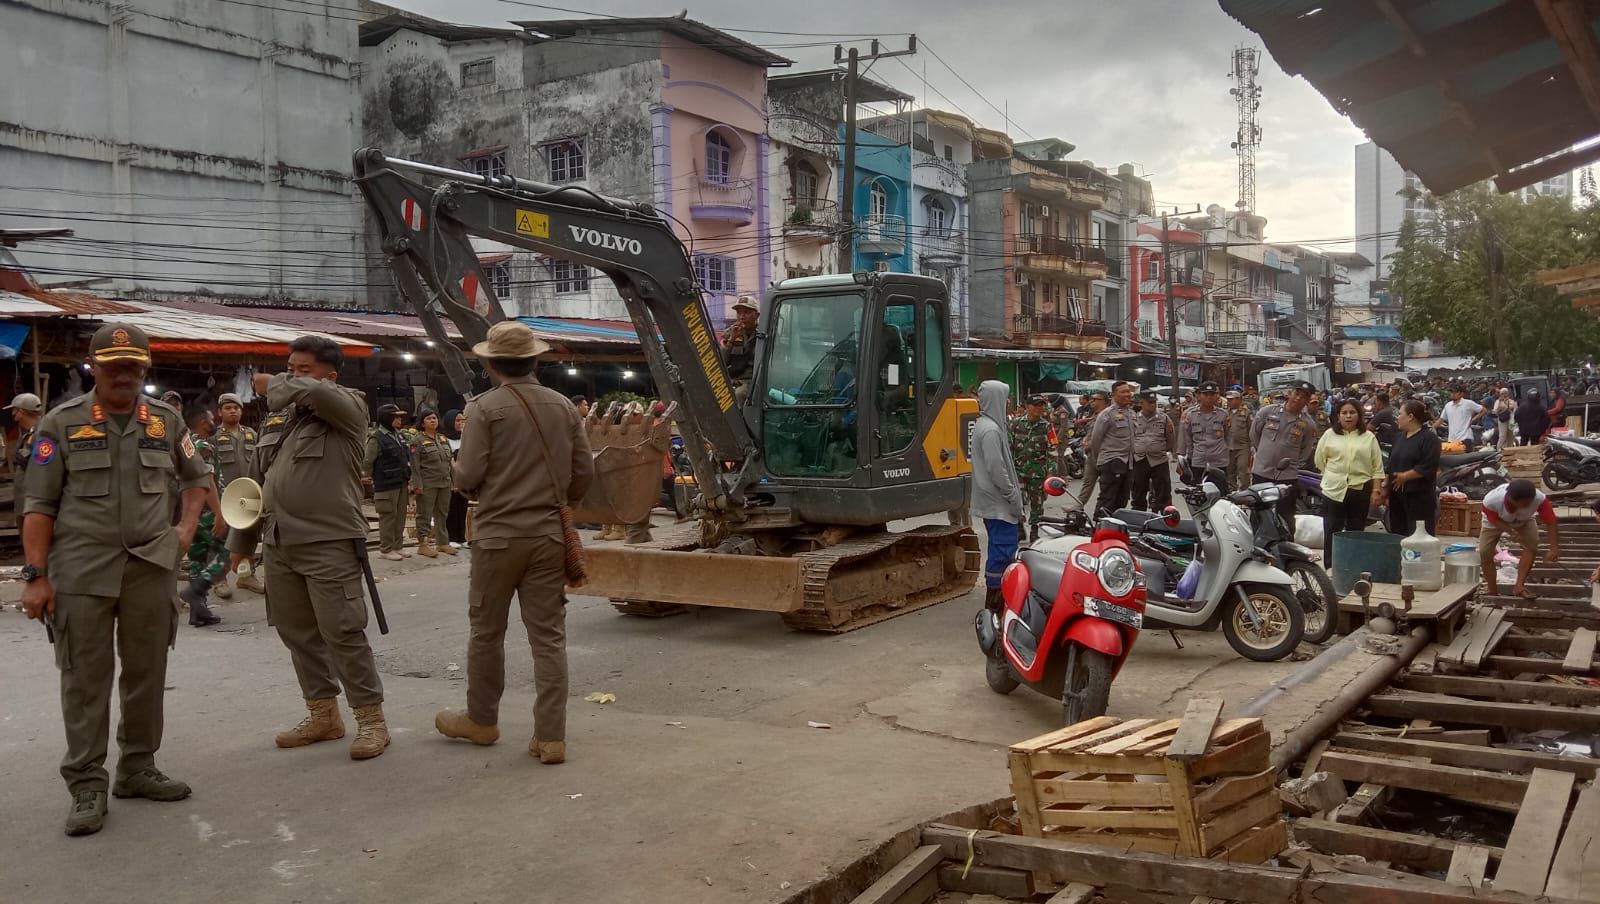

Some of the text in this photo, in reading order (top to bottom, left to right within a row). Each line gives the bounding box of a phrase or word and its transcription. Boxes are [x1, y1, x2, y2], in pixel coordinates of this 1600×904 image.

[568, 225, 642, 255] VOLVO
[690, 323, 711, 357] KOTA
[701, 350, 734, 413] BALIKPAPAN
[883, 468, 910, 478] VOLVO
